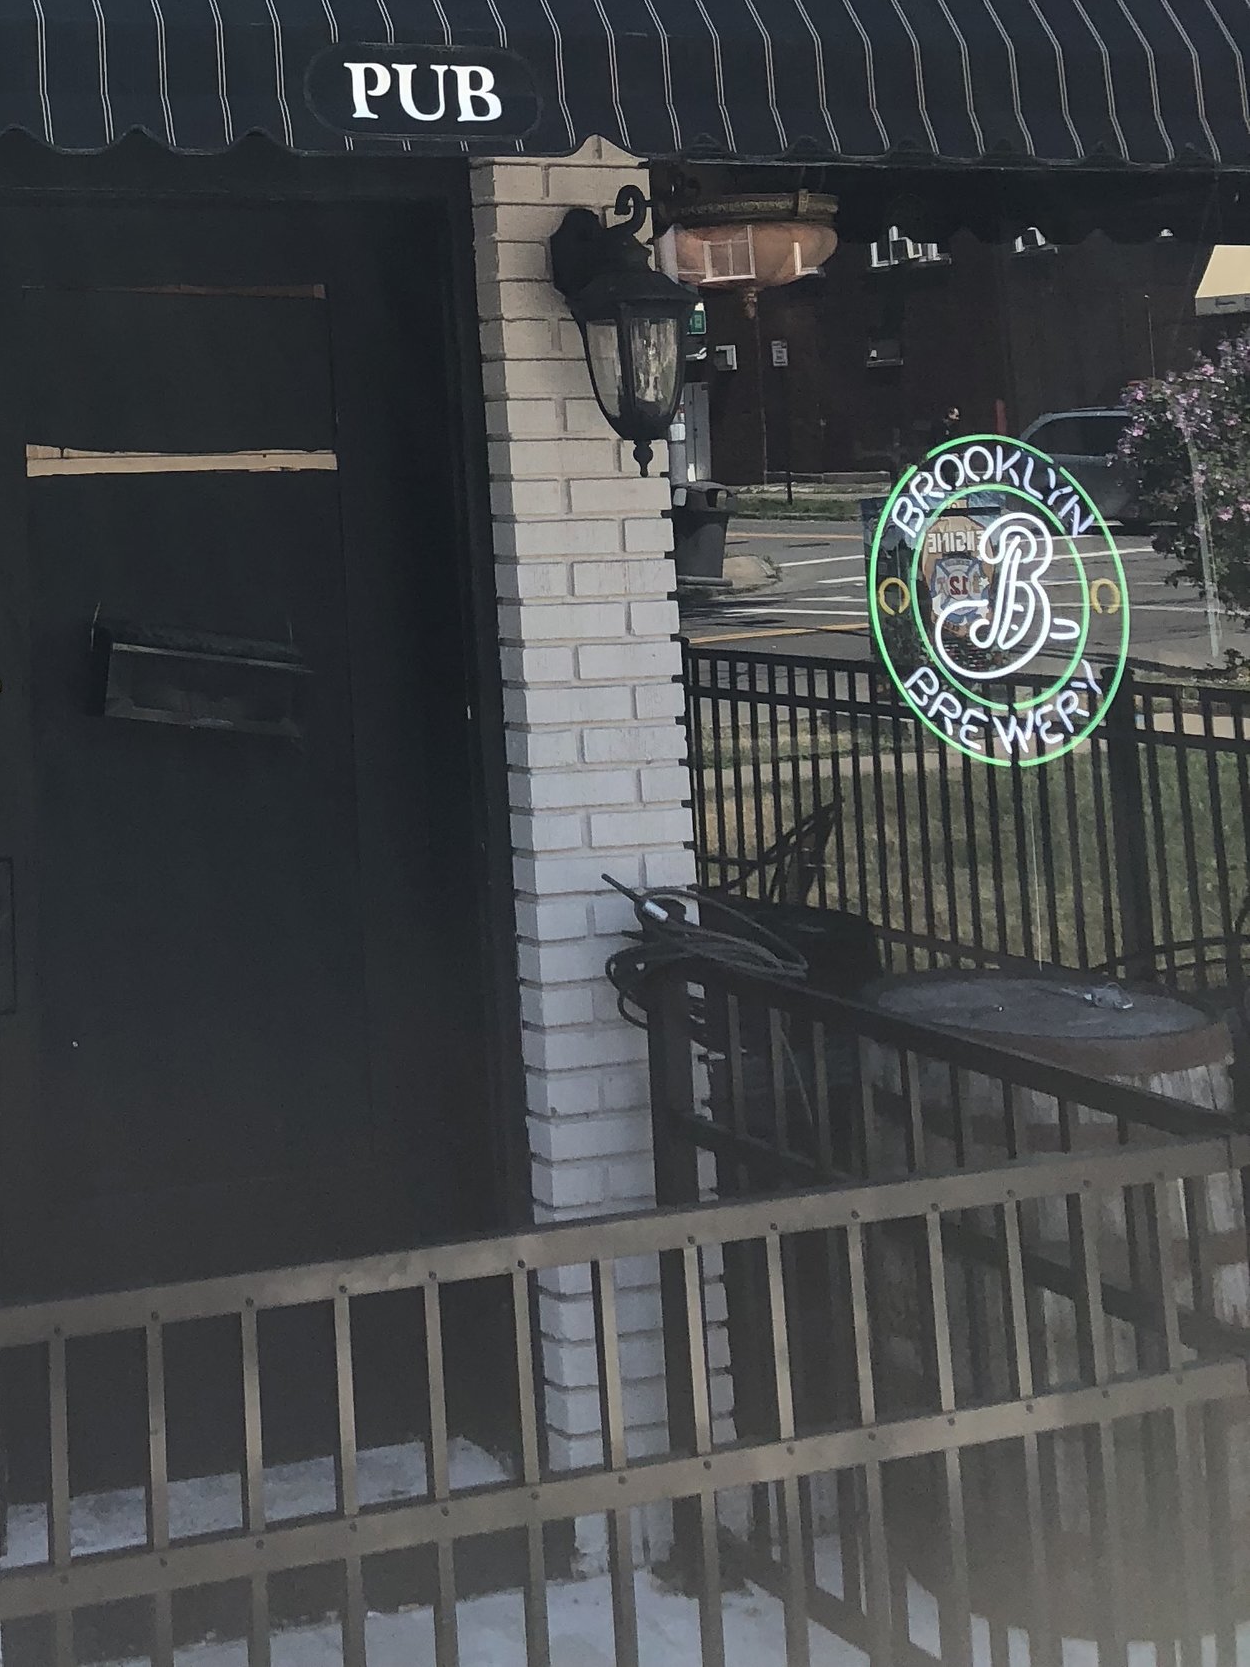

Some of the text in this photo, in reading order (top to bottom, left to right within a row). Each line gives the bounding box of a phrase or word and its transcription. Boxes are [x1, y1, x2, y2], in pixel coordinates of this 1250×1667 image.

[343, 62, 503, 123] PUB
[891, 445, 1096, 538] BROOKLYN
[904, 659, 1103, 754] BREWERY
